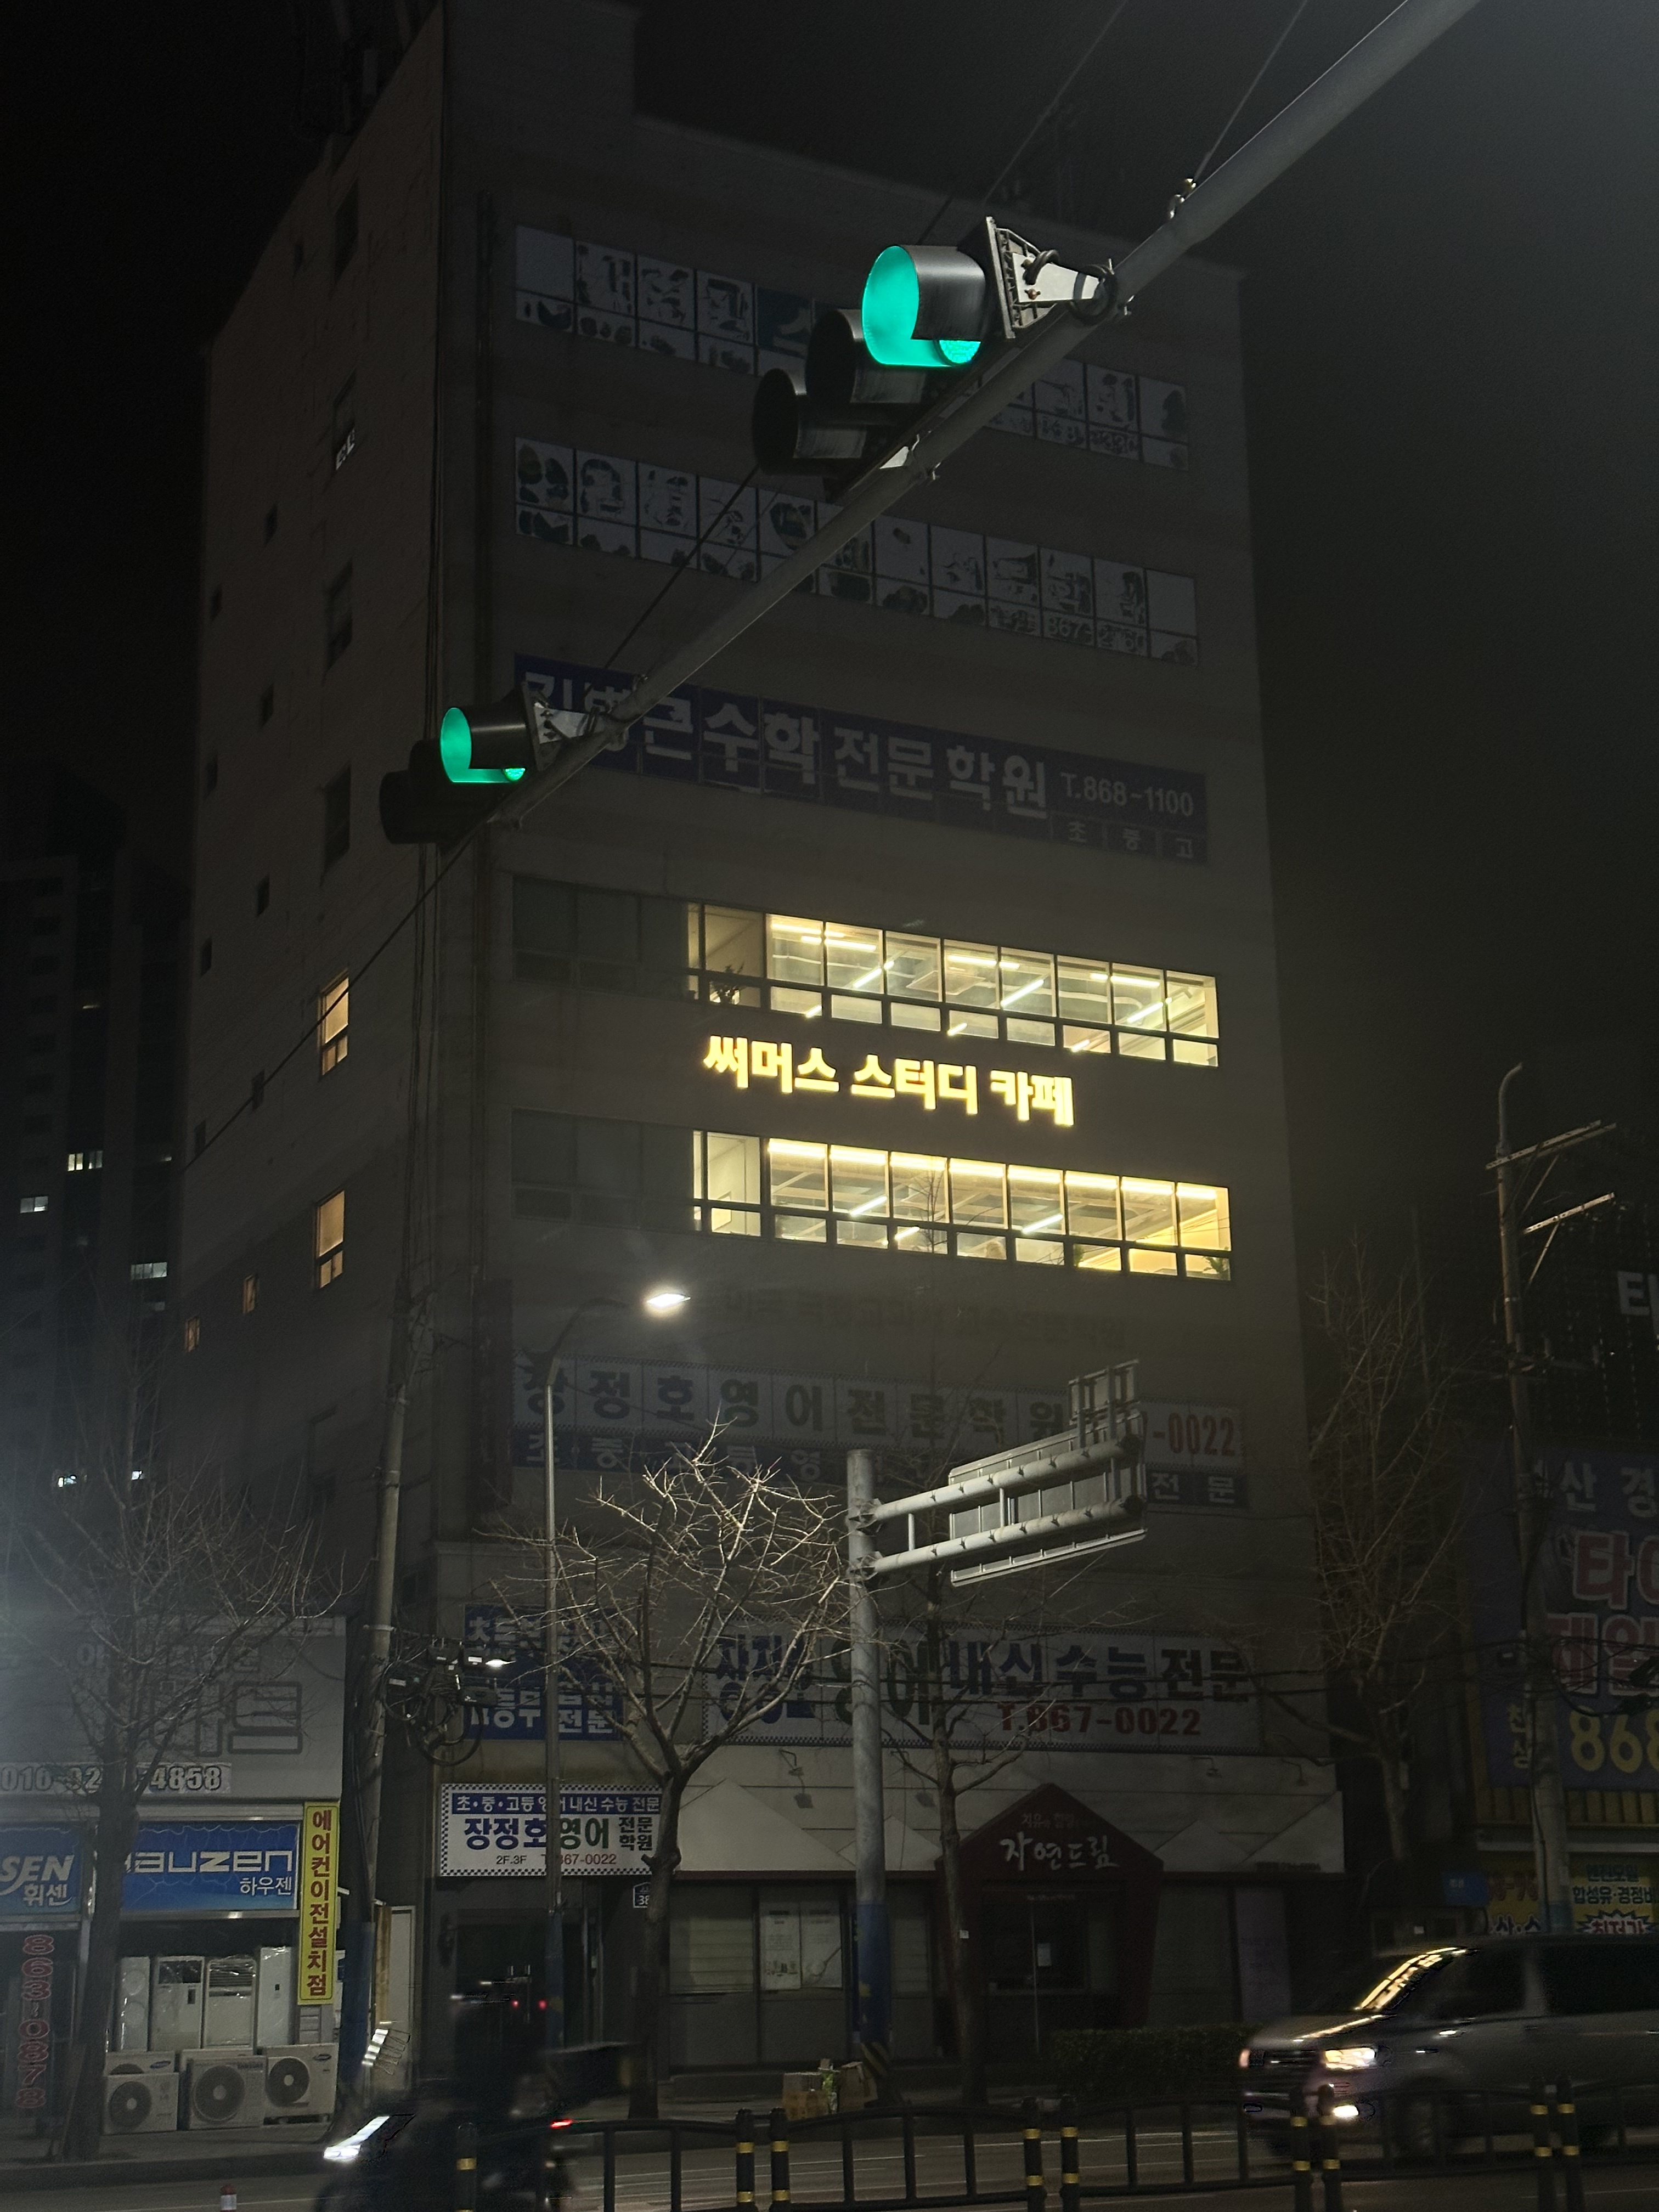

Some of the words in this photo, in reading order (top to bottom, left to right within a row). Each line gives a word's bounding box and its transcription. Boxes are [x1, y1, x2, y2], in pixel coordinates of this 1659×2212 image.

[1059, 771, 1195, 818] T.868-1100
[703, 1034, 840, 1094] 써머스
[850, 1053, 979, 1115] 스터디
[990, 1068, 1074, 1126] 카페
[569, 1796, 598, 1813] 내신
[600, 1796, 629, 1813] 수능
[632, 1796, 660, 1813] 전문
[999, 1831, 1120, 1872] 자연드림
[23, 1883, 72, 1906] 휘센
[239, 1876, 292, 1897] 하우젠
[307, 1809, 333, 1997] 에어컨이전설치점
